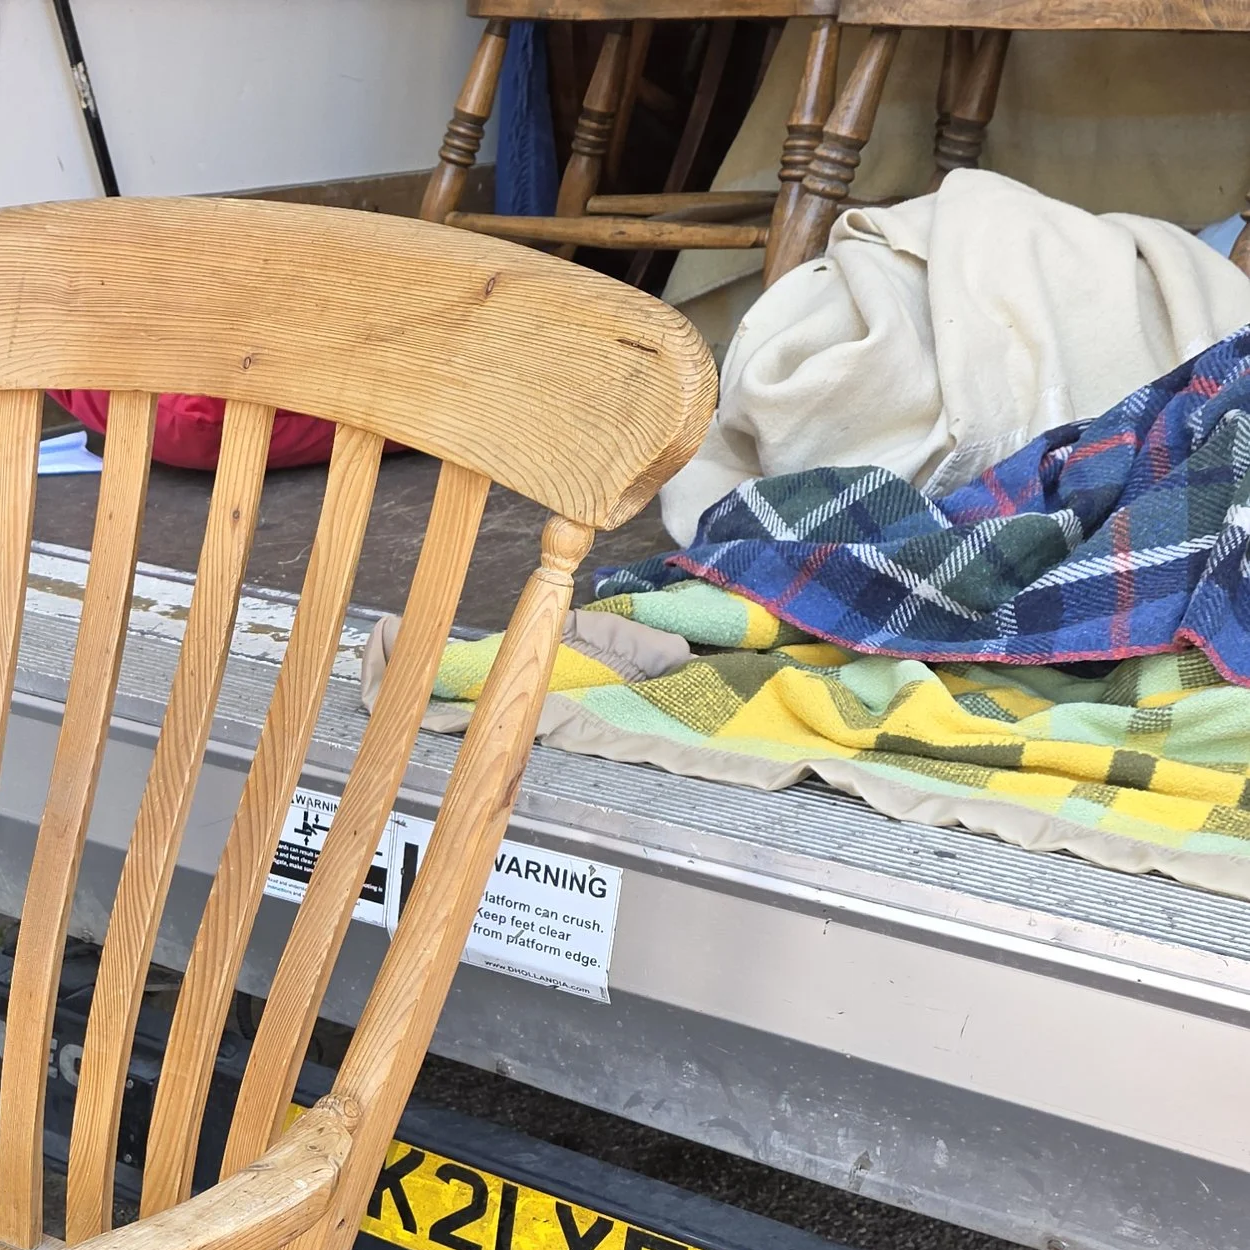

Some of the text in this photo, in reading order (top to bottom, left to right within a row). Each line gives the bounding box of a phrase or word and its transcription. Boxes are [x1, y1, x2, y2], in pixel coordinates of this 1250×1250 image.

[295, 794, 339, 812] WARNIN
[483, 890, 604, 934] latform can crush.
[510, 915, 535, 932] feet
[538, 924, 572, 942] clear
[472, 922, 601, 968] from platform edge.
[483, 960, 591, 995] www.DHOLLANDIA.com
